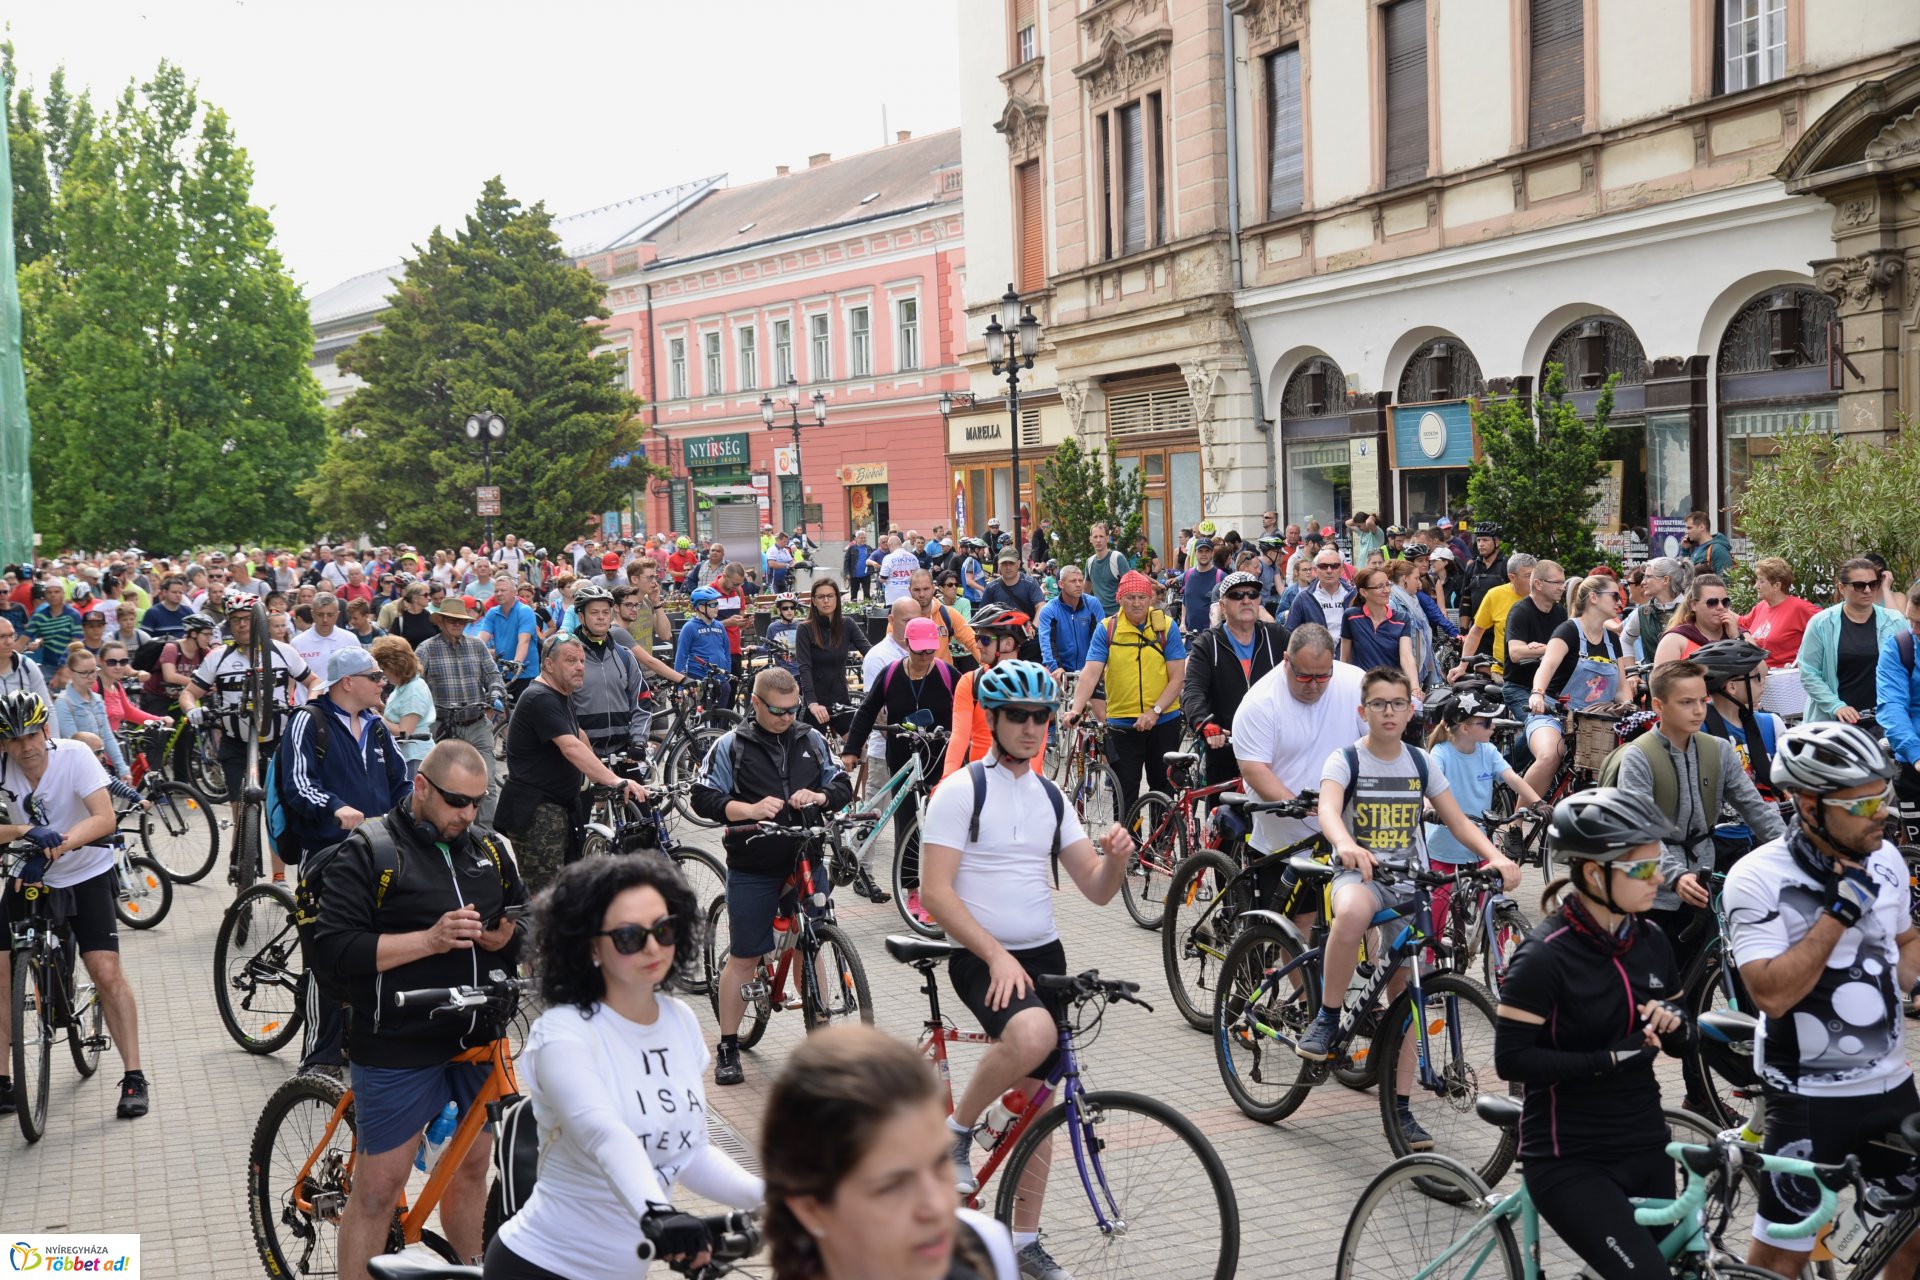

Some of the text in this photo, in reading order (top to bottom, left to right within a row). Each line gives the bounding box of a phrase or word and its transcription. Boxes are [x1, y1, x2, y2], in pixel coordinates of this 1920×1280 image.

[966, 424, 1001, 441] MARELLA
[690, 437, 741, 458] NYÍRSÉG
[1356, 803, 1420, 828] STREET
[641, 1047, 669, 1077] IT
[687, 1089, 703, 1112] A
[1837, 1223, 1861, 1252] aptonia
